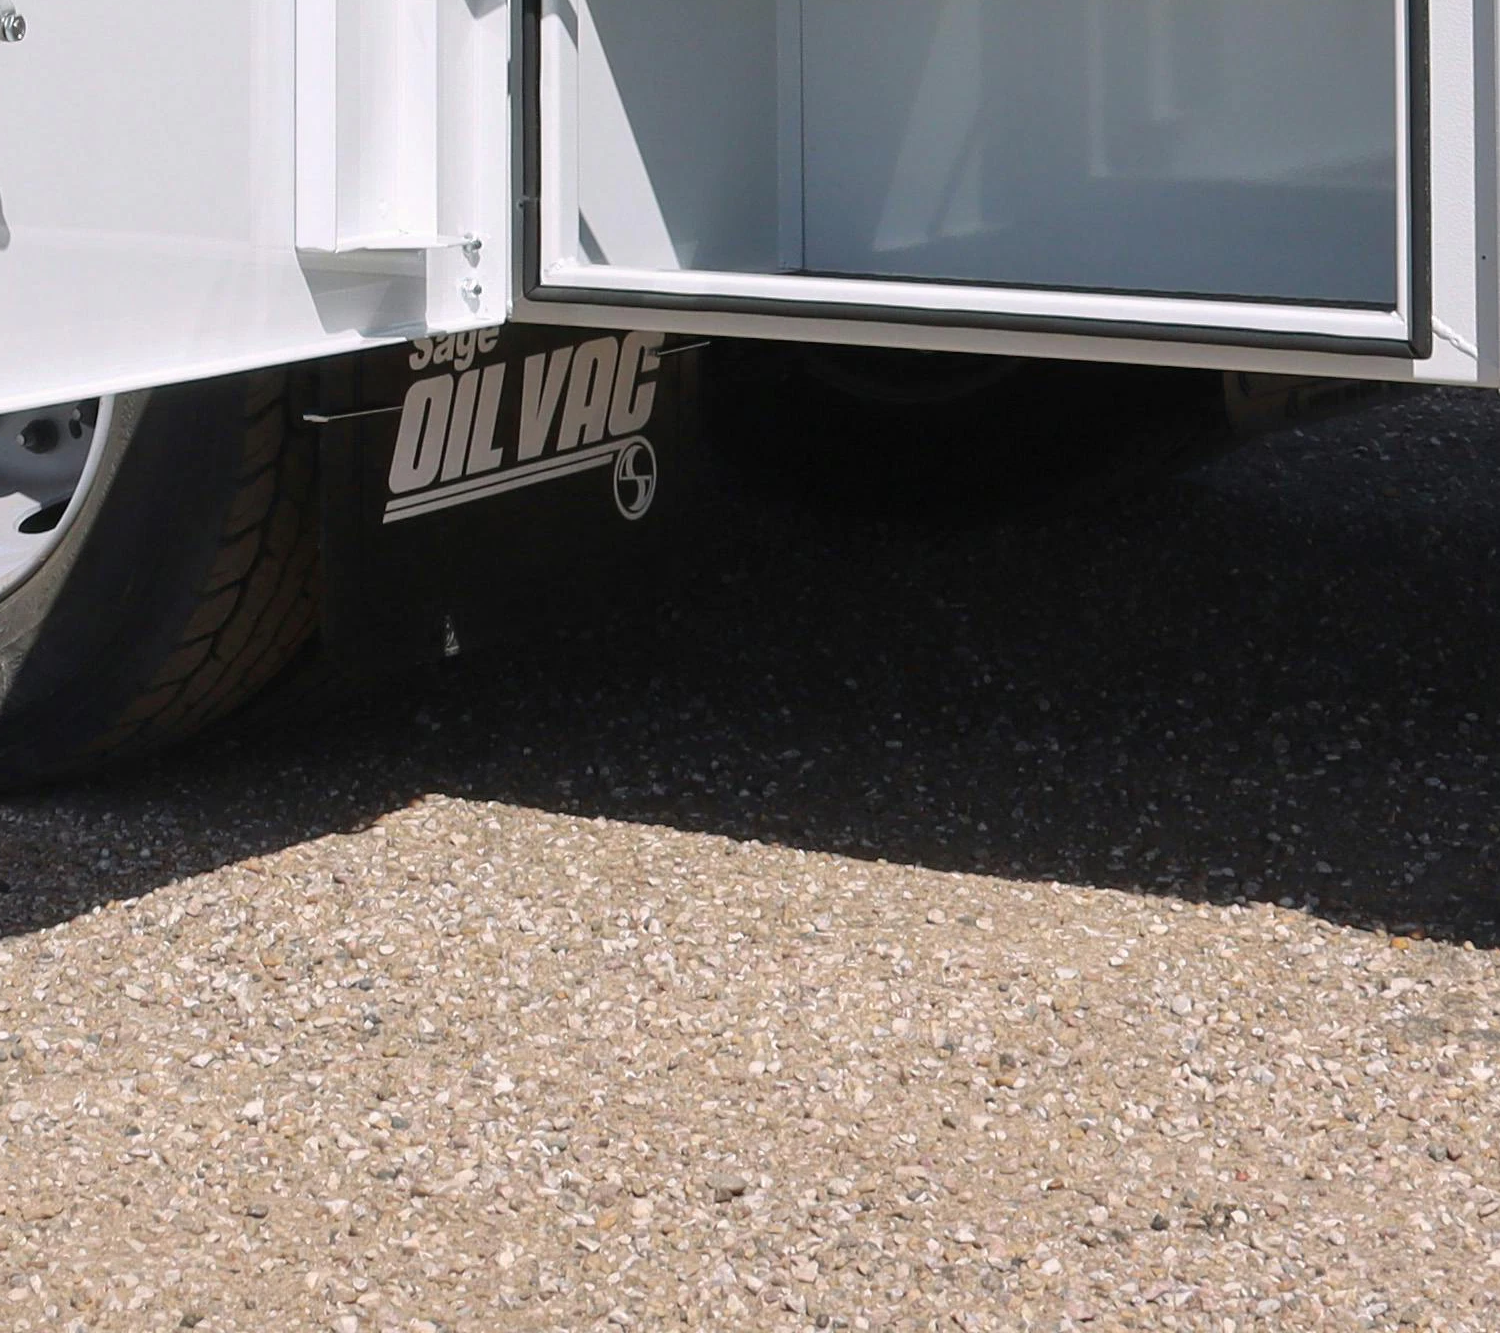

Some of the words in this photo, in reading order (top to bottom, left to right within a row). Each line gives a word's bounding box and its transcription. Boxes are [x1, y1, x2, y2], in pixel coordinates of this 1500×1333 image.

[409, 326, 499, 371] Sage
[388, 362, 506, 494] OIL
[517, 330, 665, 461] VAC
